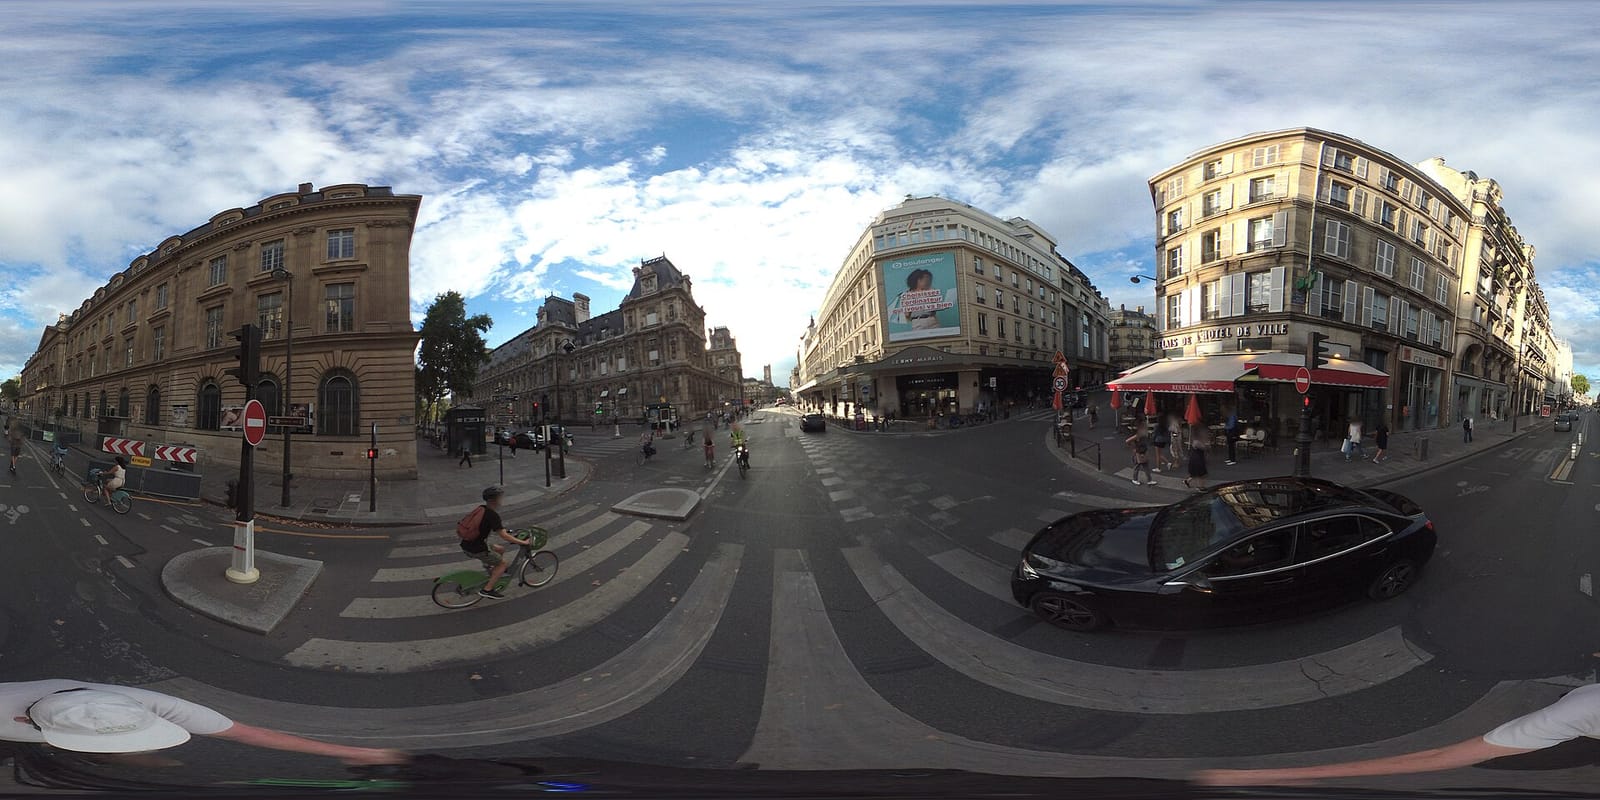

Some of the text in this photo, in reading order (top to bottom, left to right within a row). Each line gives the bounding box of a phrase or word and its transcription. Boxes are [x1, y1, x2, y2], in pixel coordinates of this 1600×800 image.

[903, 257, 944, 267] boulanger
[1153, 338, 1178, 349] RELAIS
[1183, 336, 1192, 346] DE
[1237, 326, 1250, 338] DE
[1257, 323, 1288, 336] VILLE
